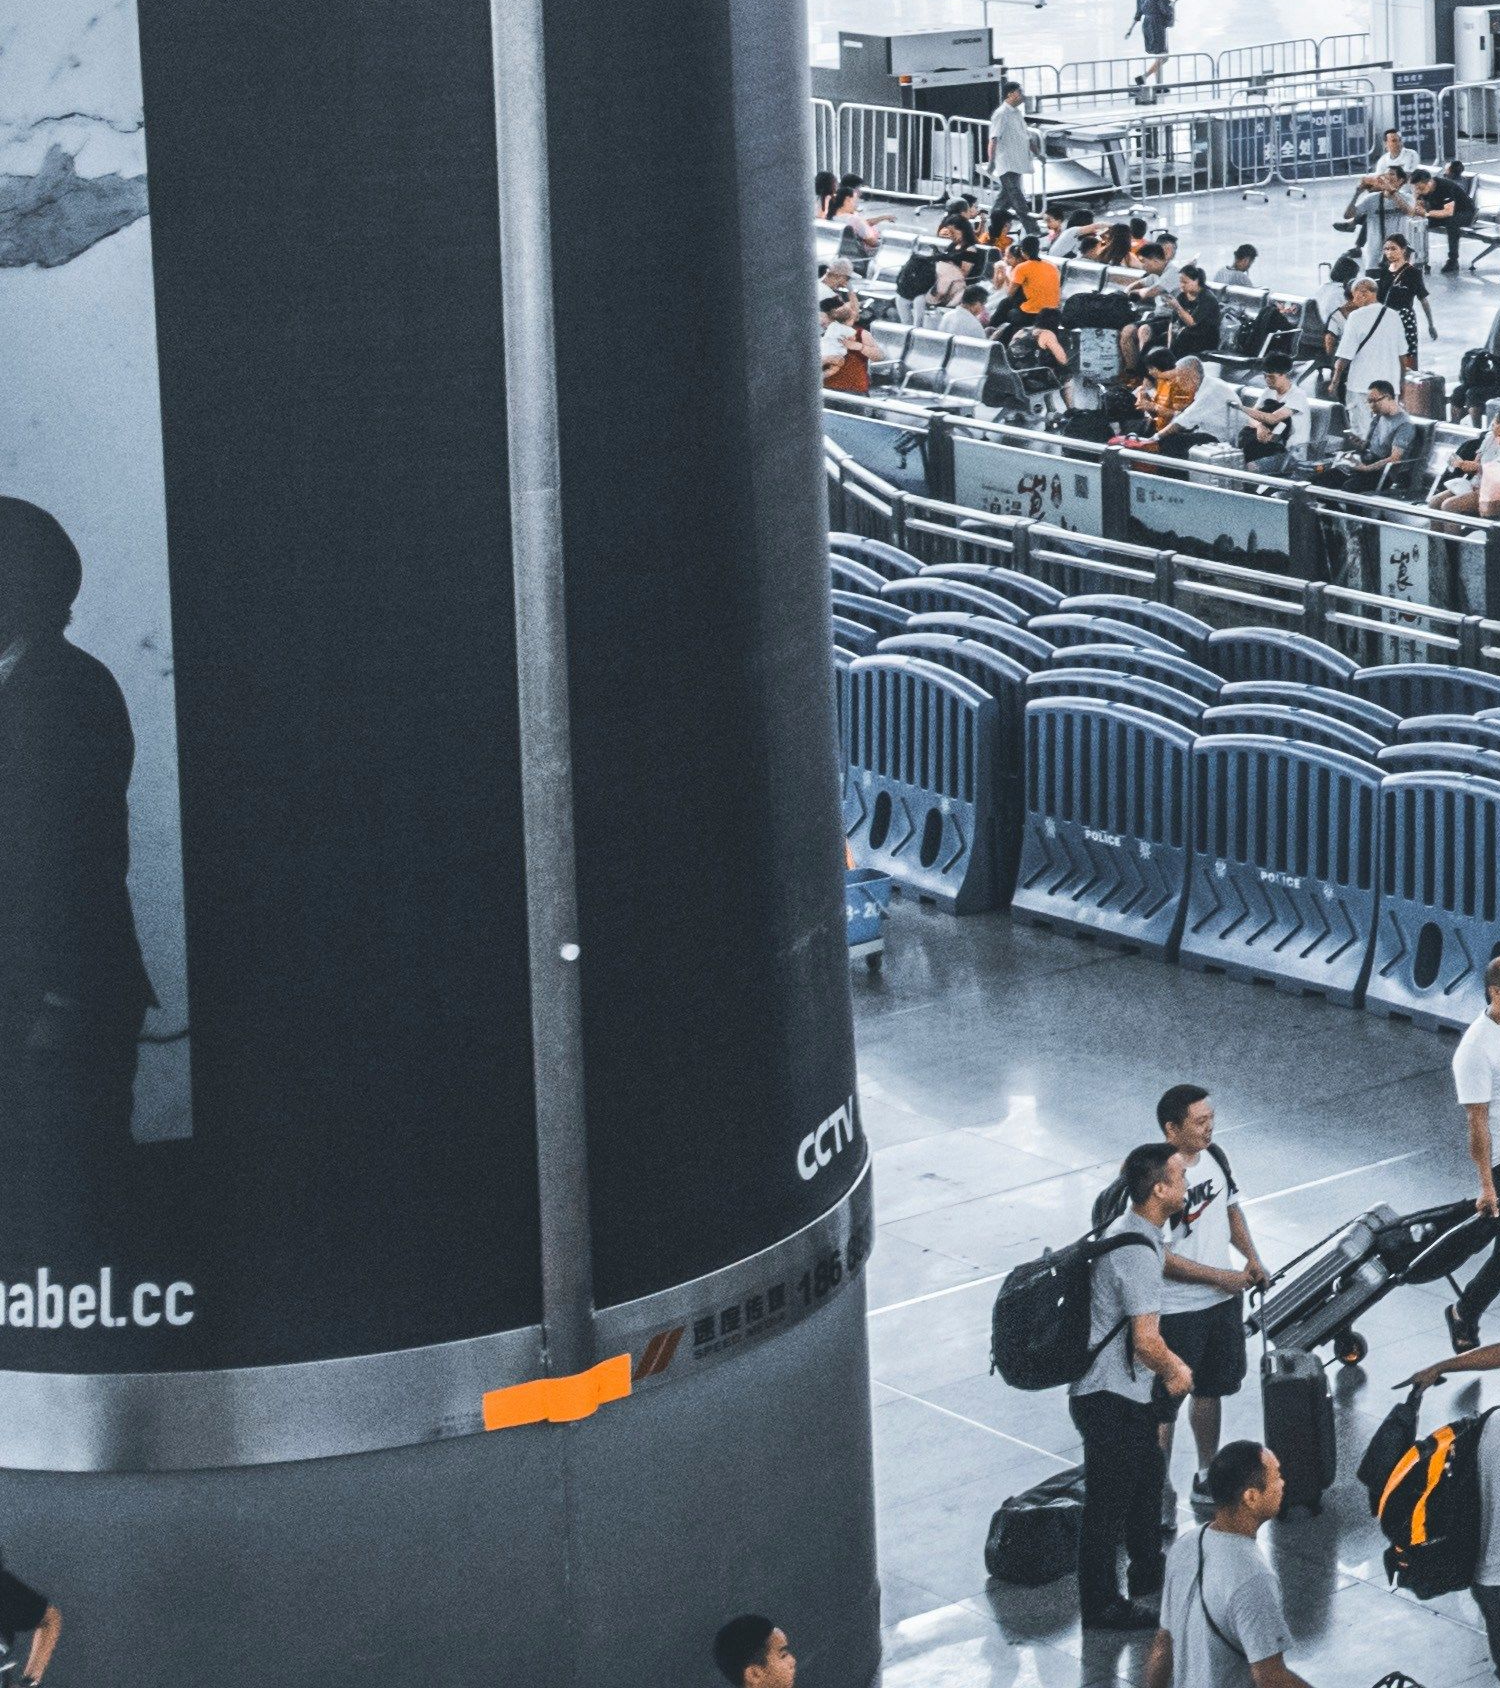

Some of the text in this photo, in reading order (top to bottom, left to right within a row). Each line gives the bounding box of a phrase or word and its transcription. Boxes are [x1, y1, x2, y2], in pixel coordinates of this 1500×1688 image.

[1085, 829, 1122, 847] POLICE
[1260, 870, 1301, 889] POLICE
[798, 1095, 854, 1180] CCTV
